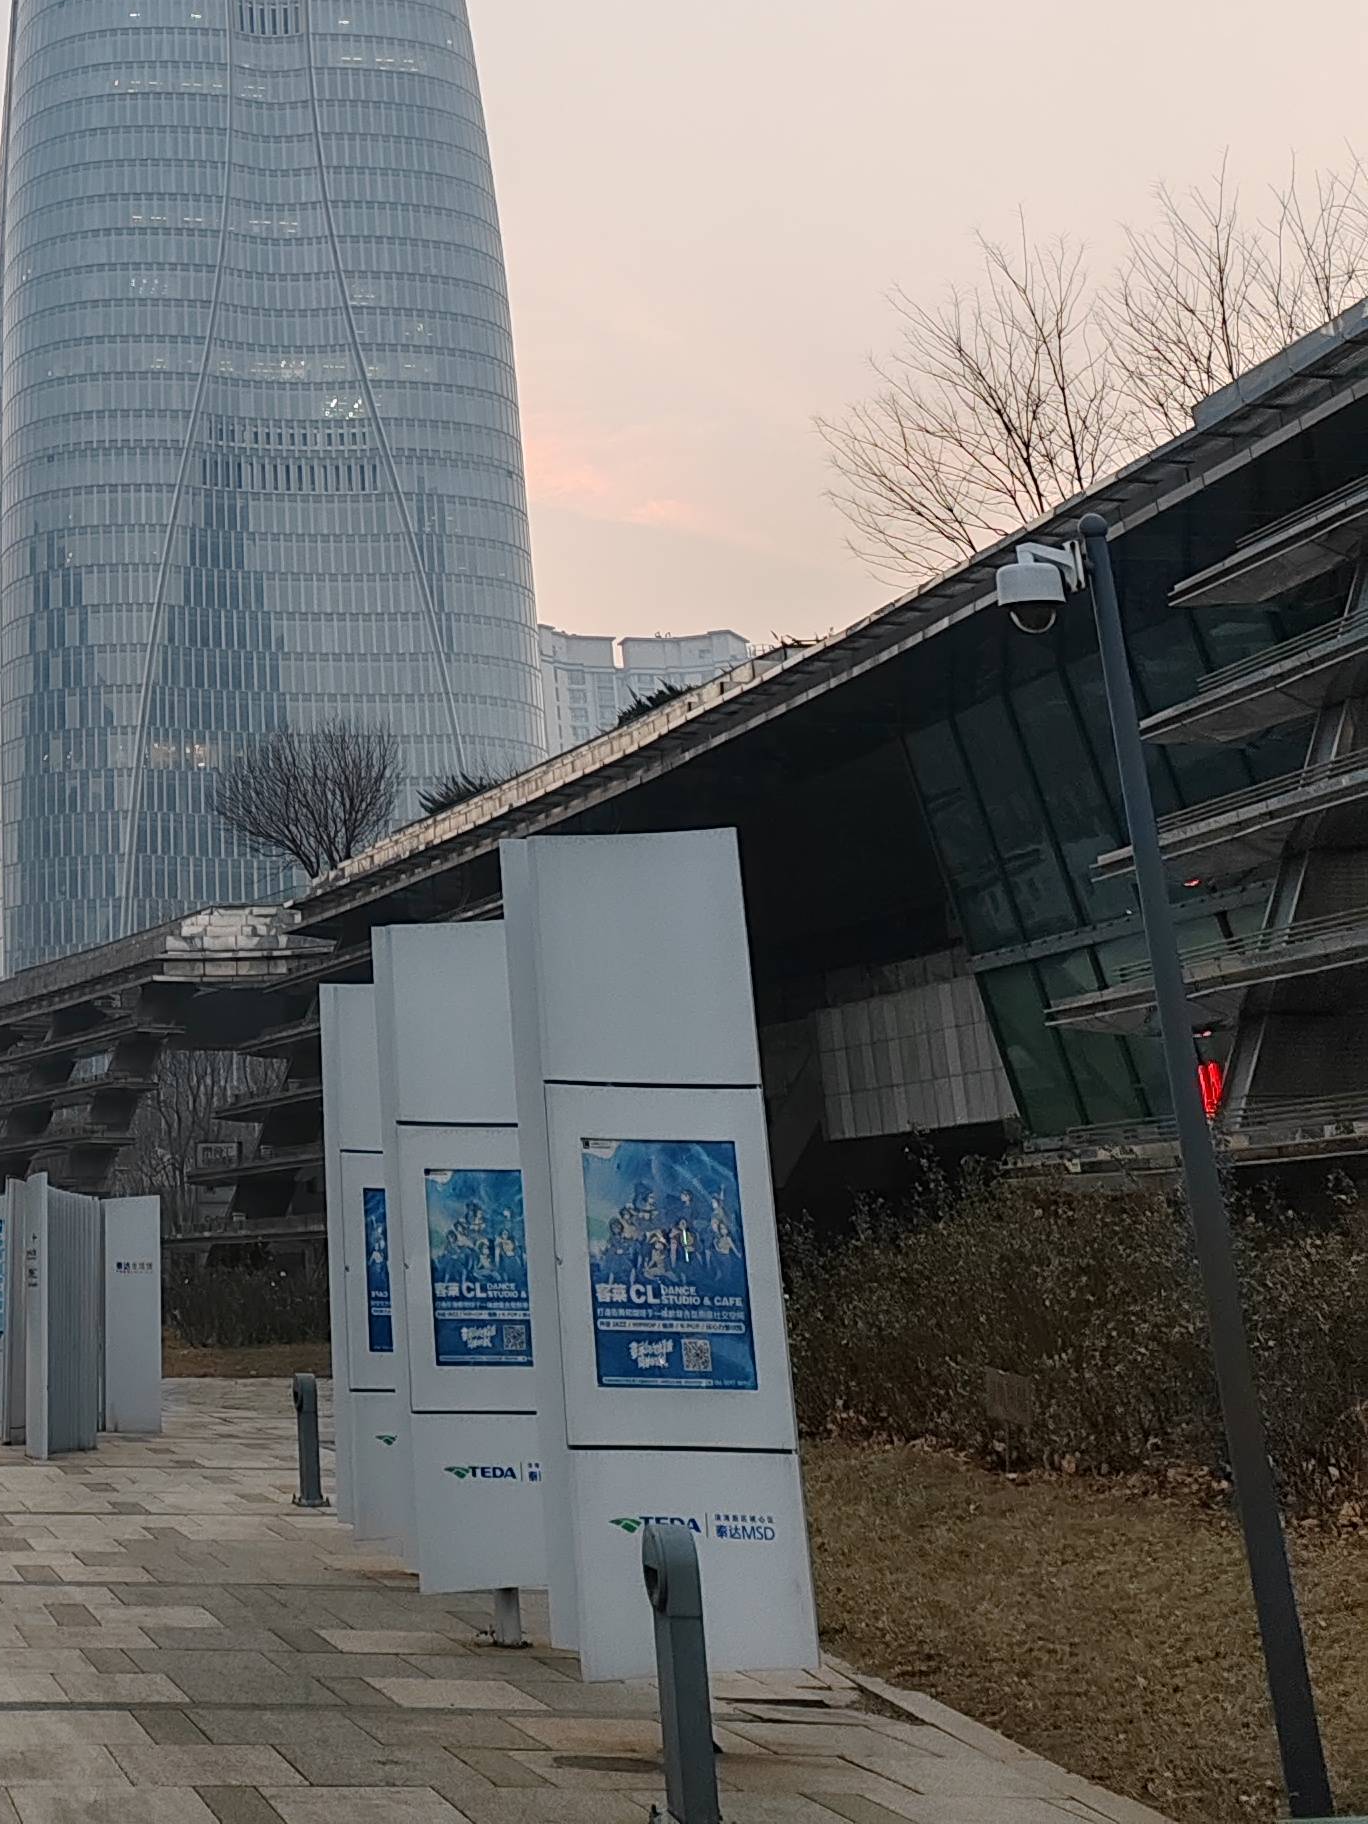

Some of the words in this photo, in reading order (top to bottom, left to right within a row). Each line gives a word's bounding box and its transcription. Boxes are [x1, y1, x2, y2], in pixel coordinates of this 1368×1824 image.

[630, 1284, 660, 1304] CL
[660, 1285, 697, 1295] DANCE
[660, 1295, 701, 1306] STUDIO
[713, 1296, 743, 1307] CAFE
[468, 1466, 516, 1479] TEDA
